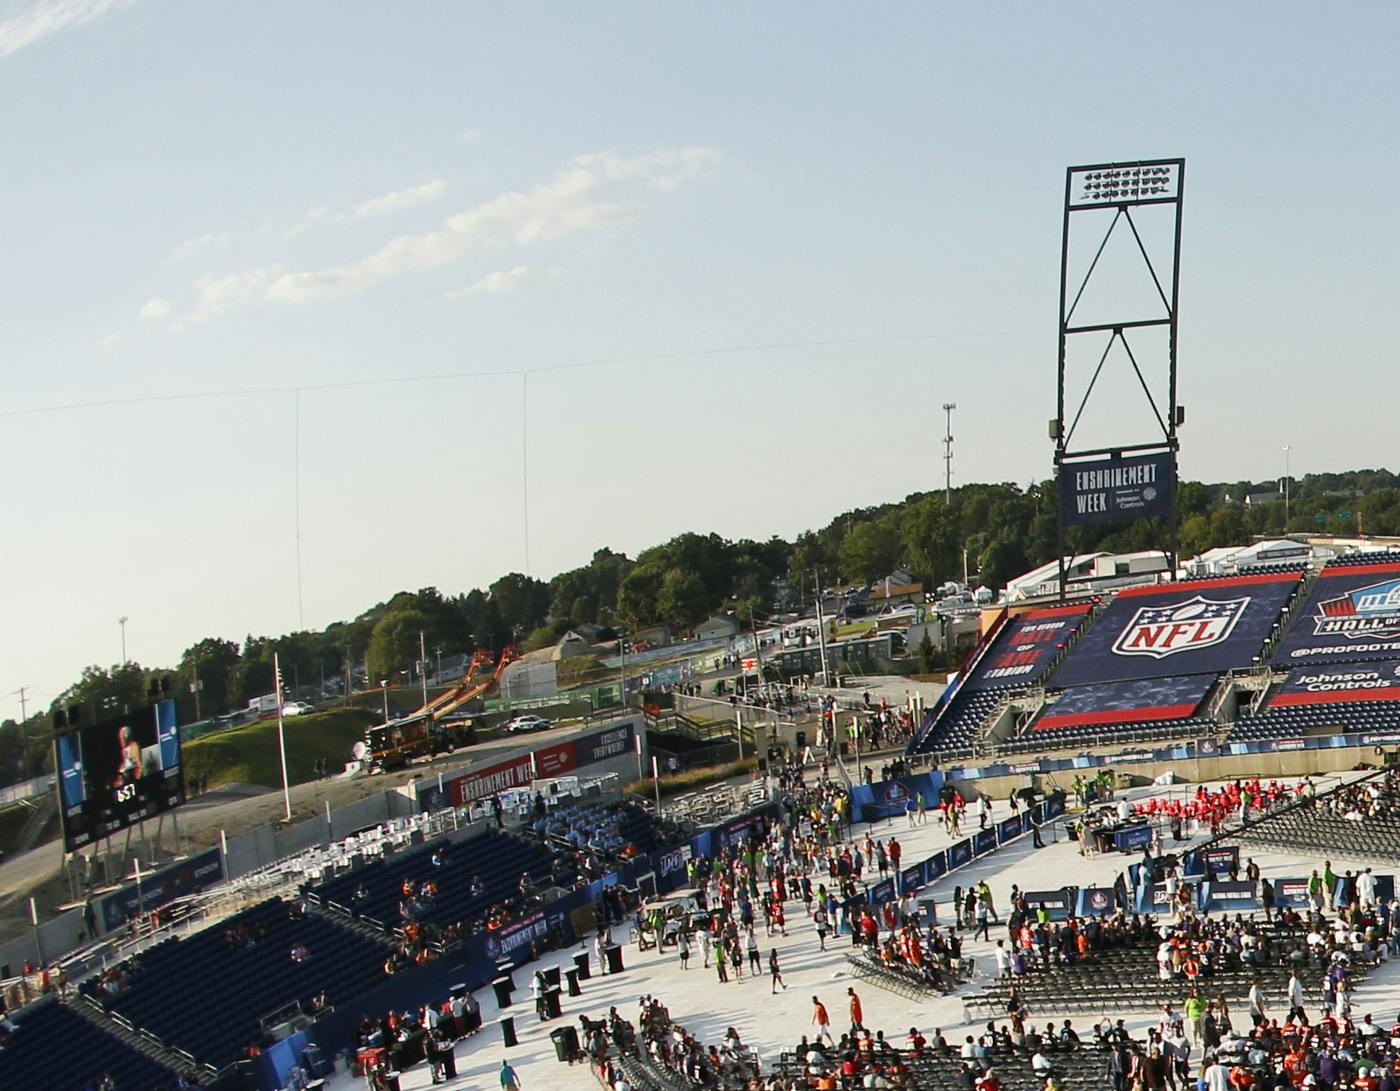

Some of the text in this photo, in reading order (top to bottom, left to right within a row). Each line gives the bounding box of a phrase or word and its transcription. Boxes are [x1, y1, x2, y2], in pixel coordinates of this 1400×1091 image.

[1076, 463, 1157, 491] ENSHRINEMENT
[1076, 492, 1107, 514] WEEK
[1324, 618, 1386, 632] HALL
[1128, 621, 1217, 649] NFL
[1017, 644, 1035, 652] OF
[983, 664, 1034, 679] STADIUM
[1295, 671, 1380, 685] Johnson
[1306, 679, 1391, 692] Controls
[461, 767, 514, 803] ENSHRINEMENT
